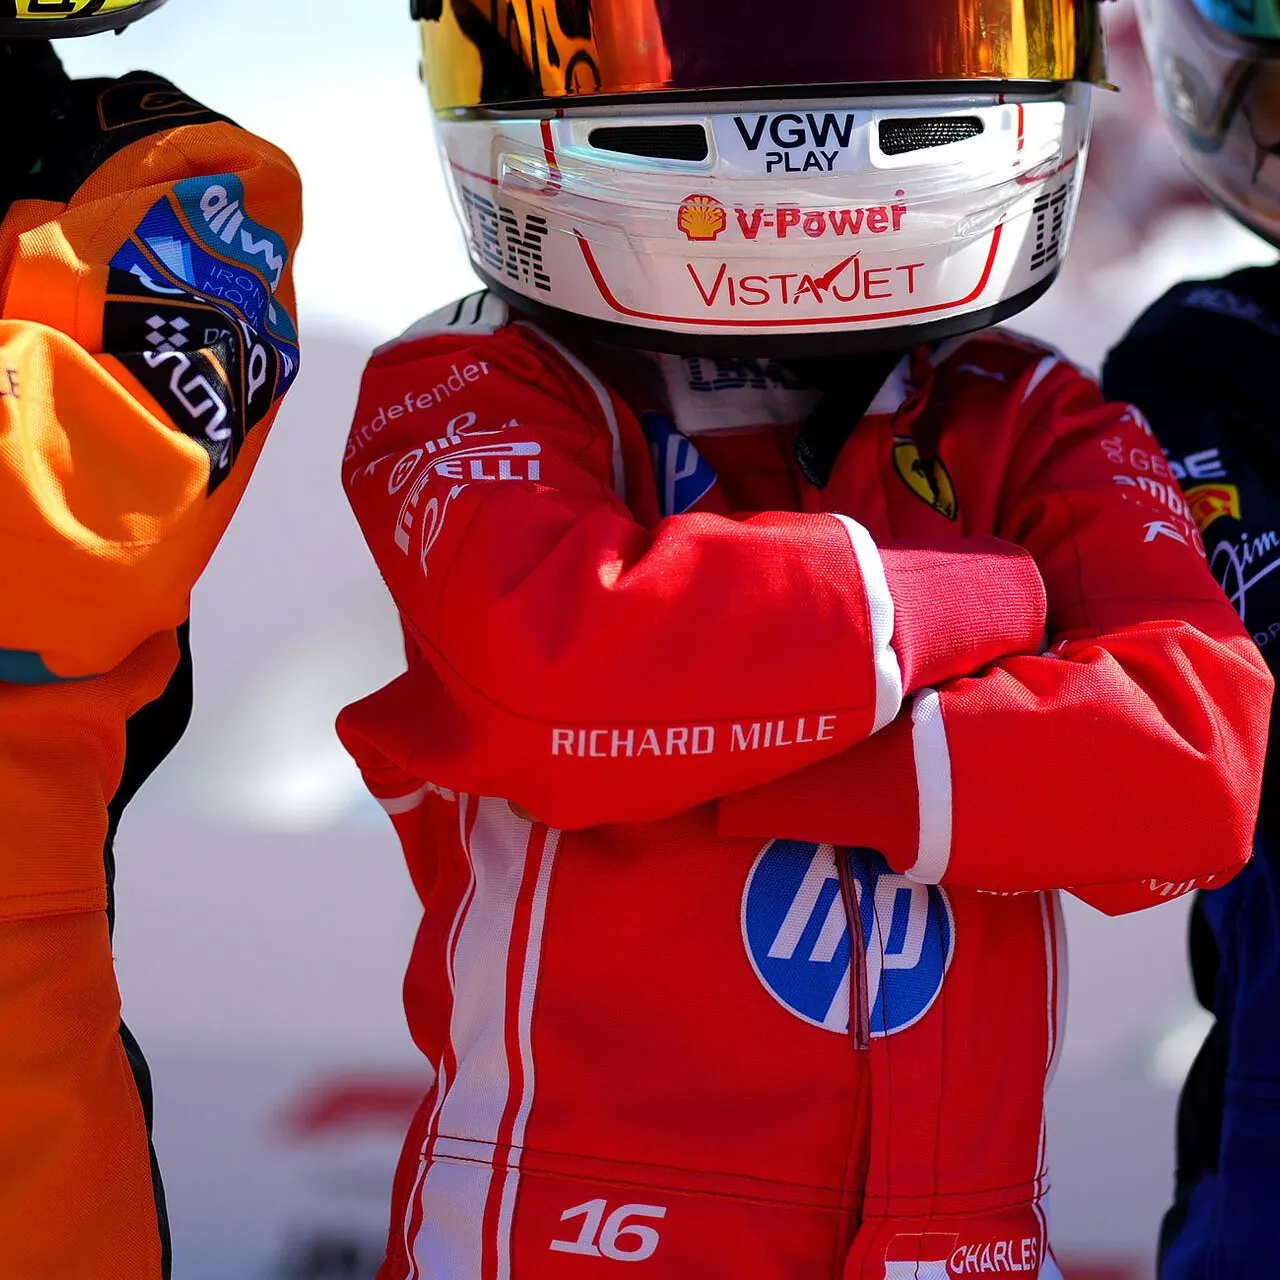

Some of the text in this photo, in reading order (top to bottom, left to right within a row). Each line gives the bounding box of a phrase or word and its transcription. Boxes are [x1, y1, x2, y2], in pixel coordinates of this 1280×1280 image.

[733, 114, 854, 150] VGW
[766, 150, 839, 173] PLAY
[461, 184, 552, 292] IBM
[736, 198, 907, 240] V-Power
[209, 265, 264, 310] IRON
[551, 715, 837, 758] RICHARD MILLE
[549, 1199, 667, 1263] 16
[950, 1236, 1037, 1274] CHARLES
